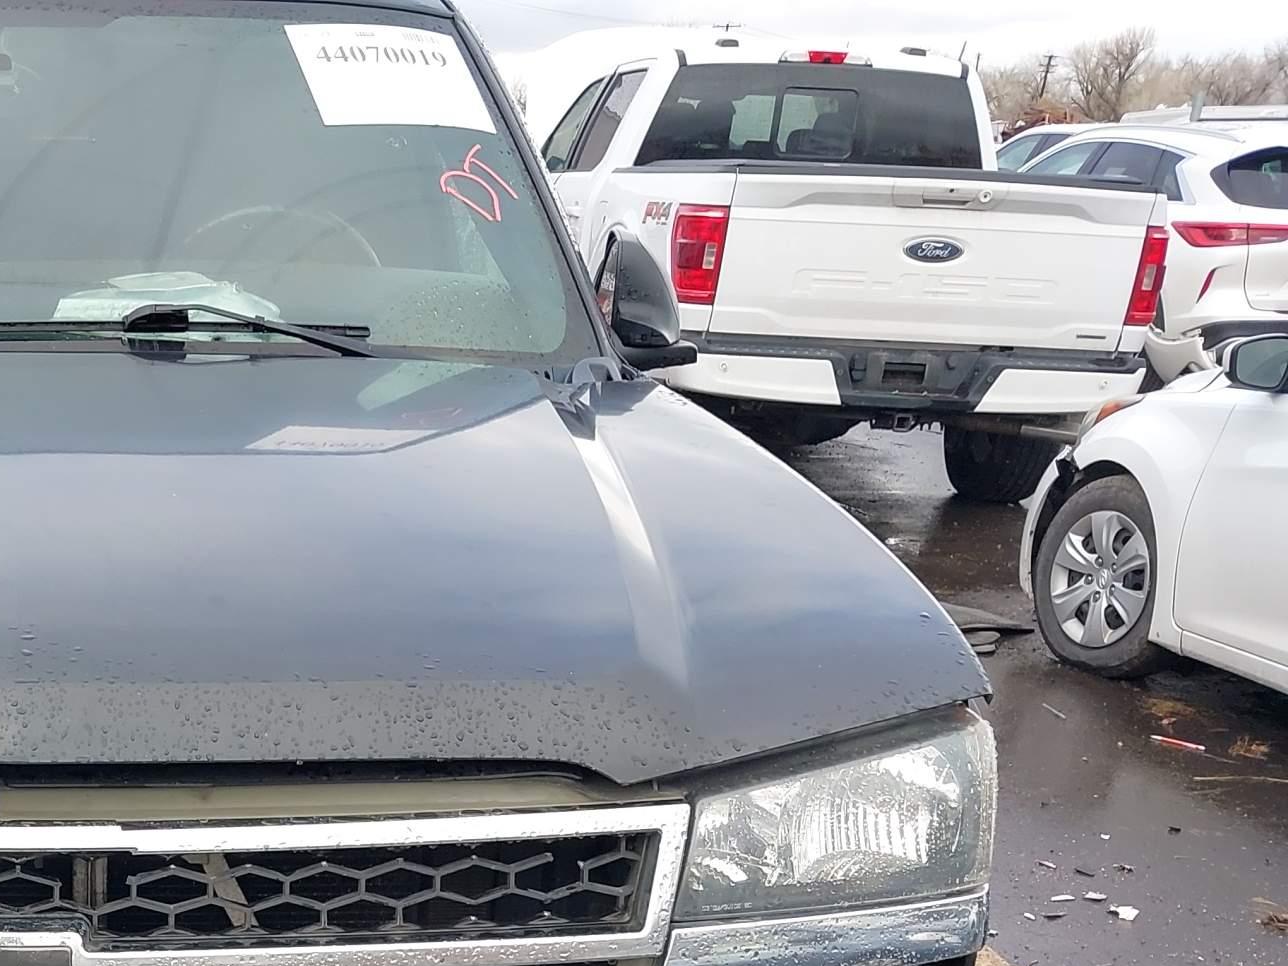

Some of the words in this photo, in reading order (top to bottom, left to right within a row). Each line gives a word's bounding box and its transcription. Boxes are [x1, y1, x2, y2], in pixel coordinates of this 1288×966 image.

[316, 46, 447, 67] 44070019
[642, 201, 673, 224] FX4
[917, 241, 952, 258] Ford
